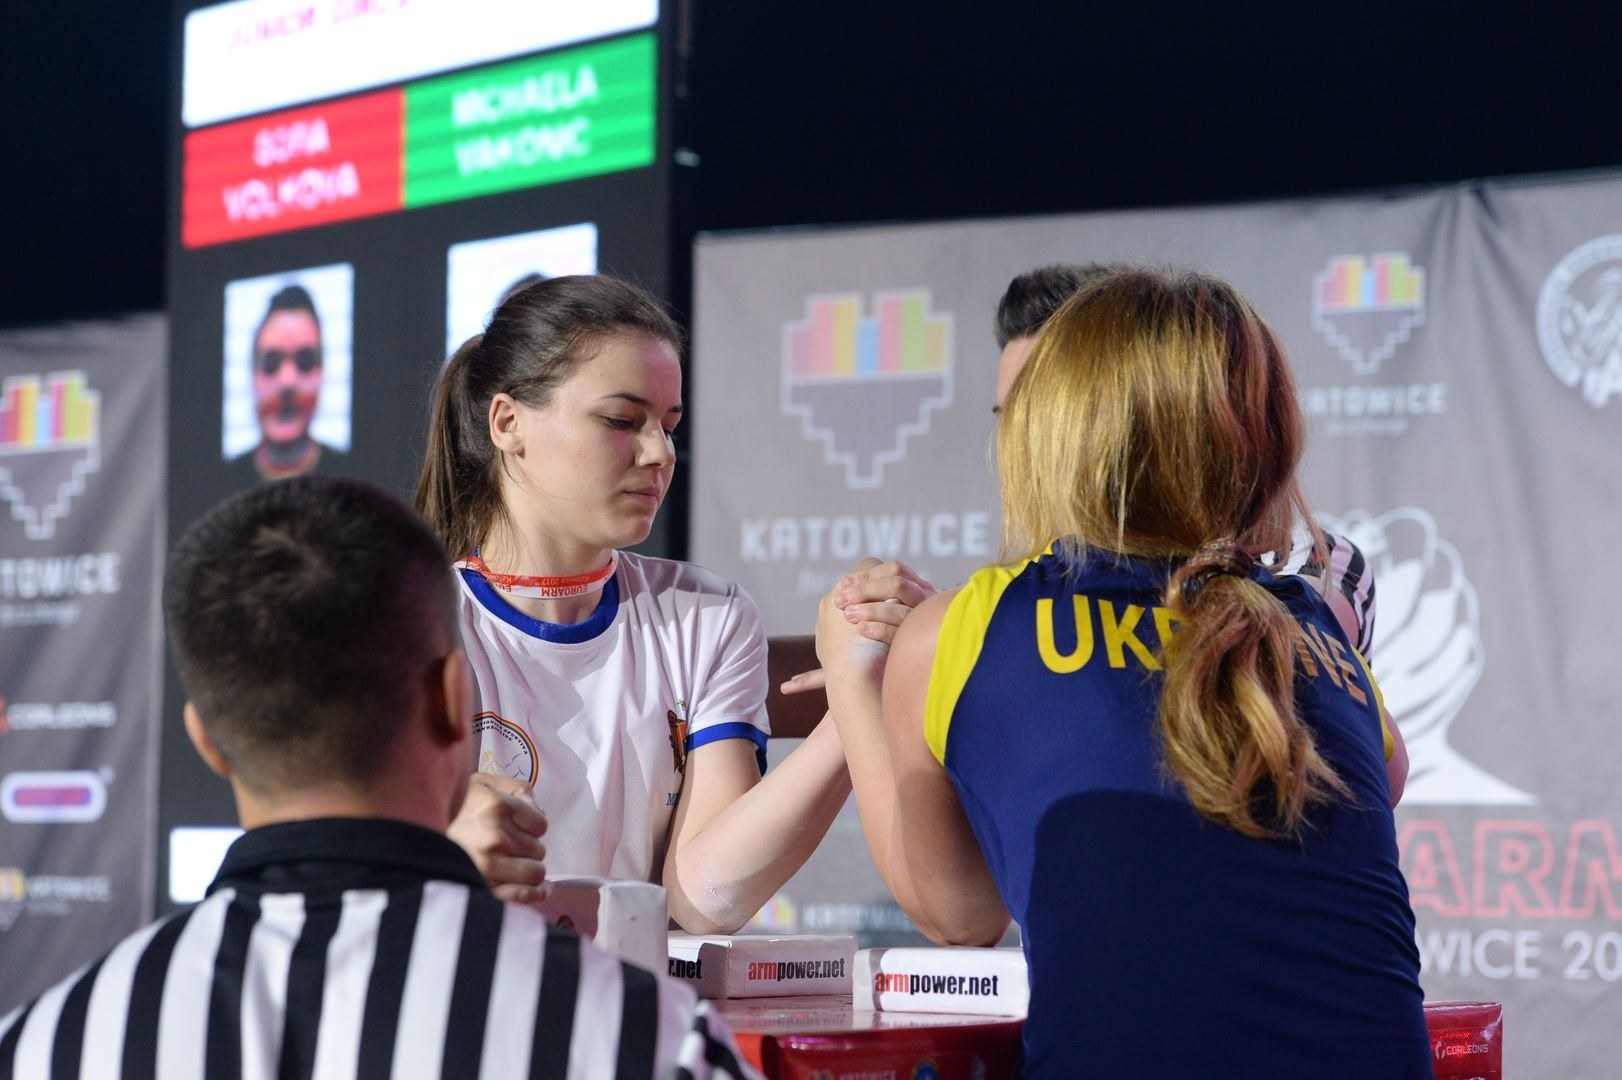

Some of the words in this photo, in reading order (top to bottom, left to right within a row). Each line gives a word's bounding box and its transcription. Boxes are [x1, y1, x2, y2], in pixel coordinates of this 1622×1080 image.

[740, 513, 992, 563] KATOWICE
[541, 583, 588, 597] EUROARM
[1036, 594, 1369, 707] UKNE
[748, 958, 845, 982] armpower.net
[875, 972, 999, 996] armpower.net
